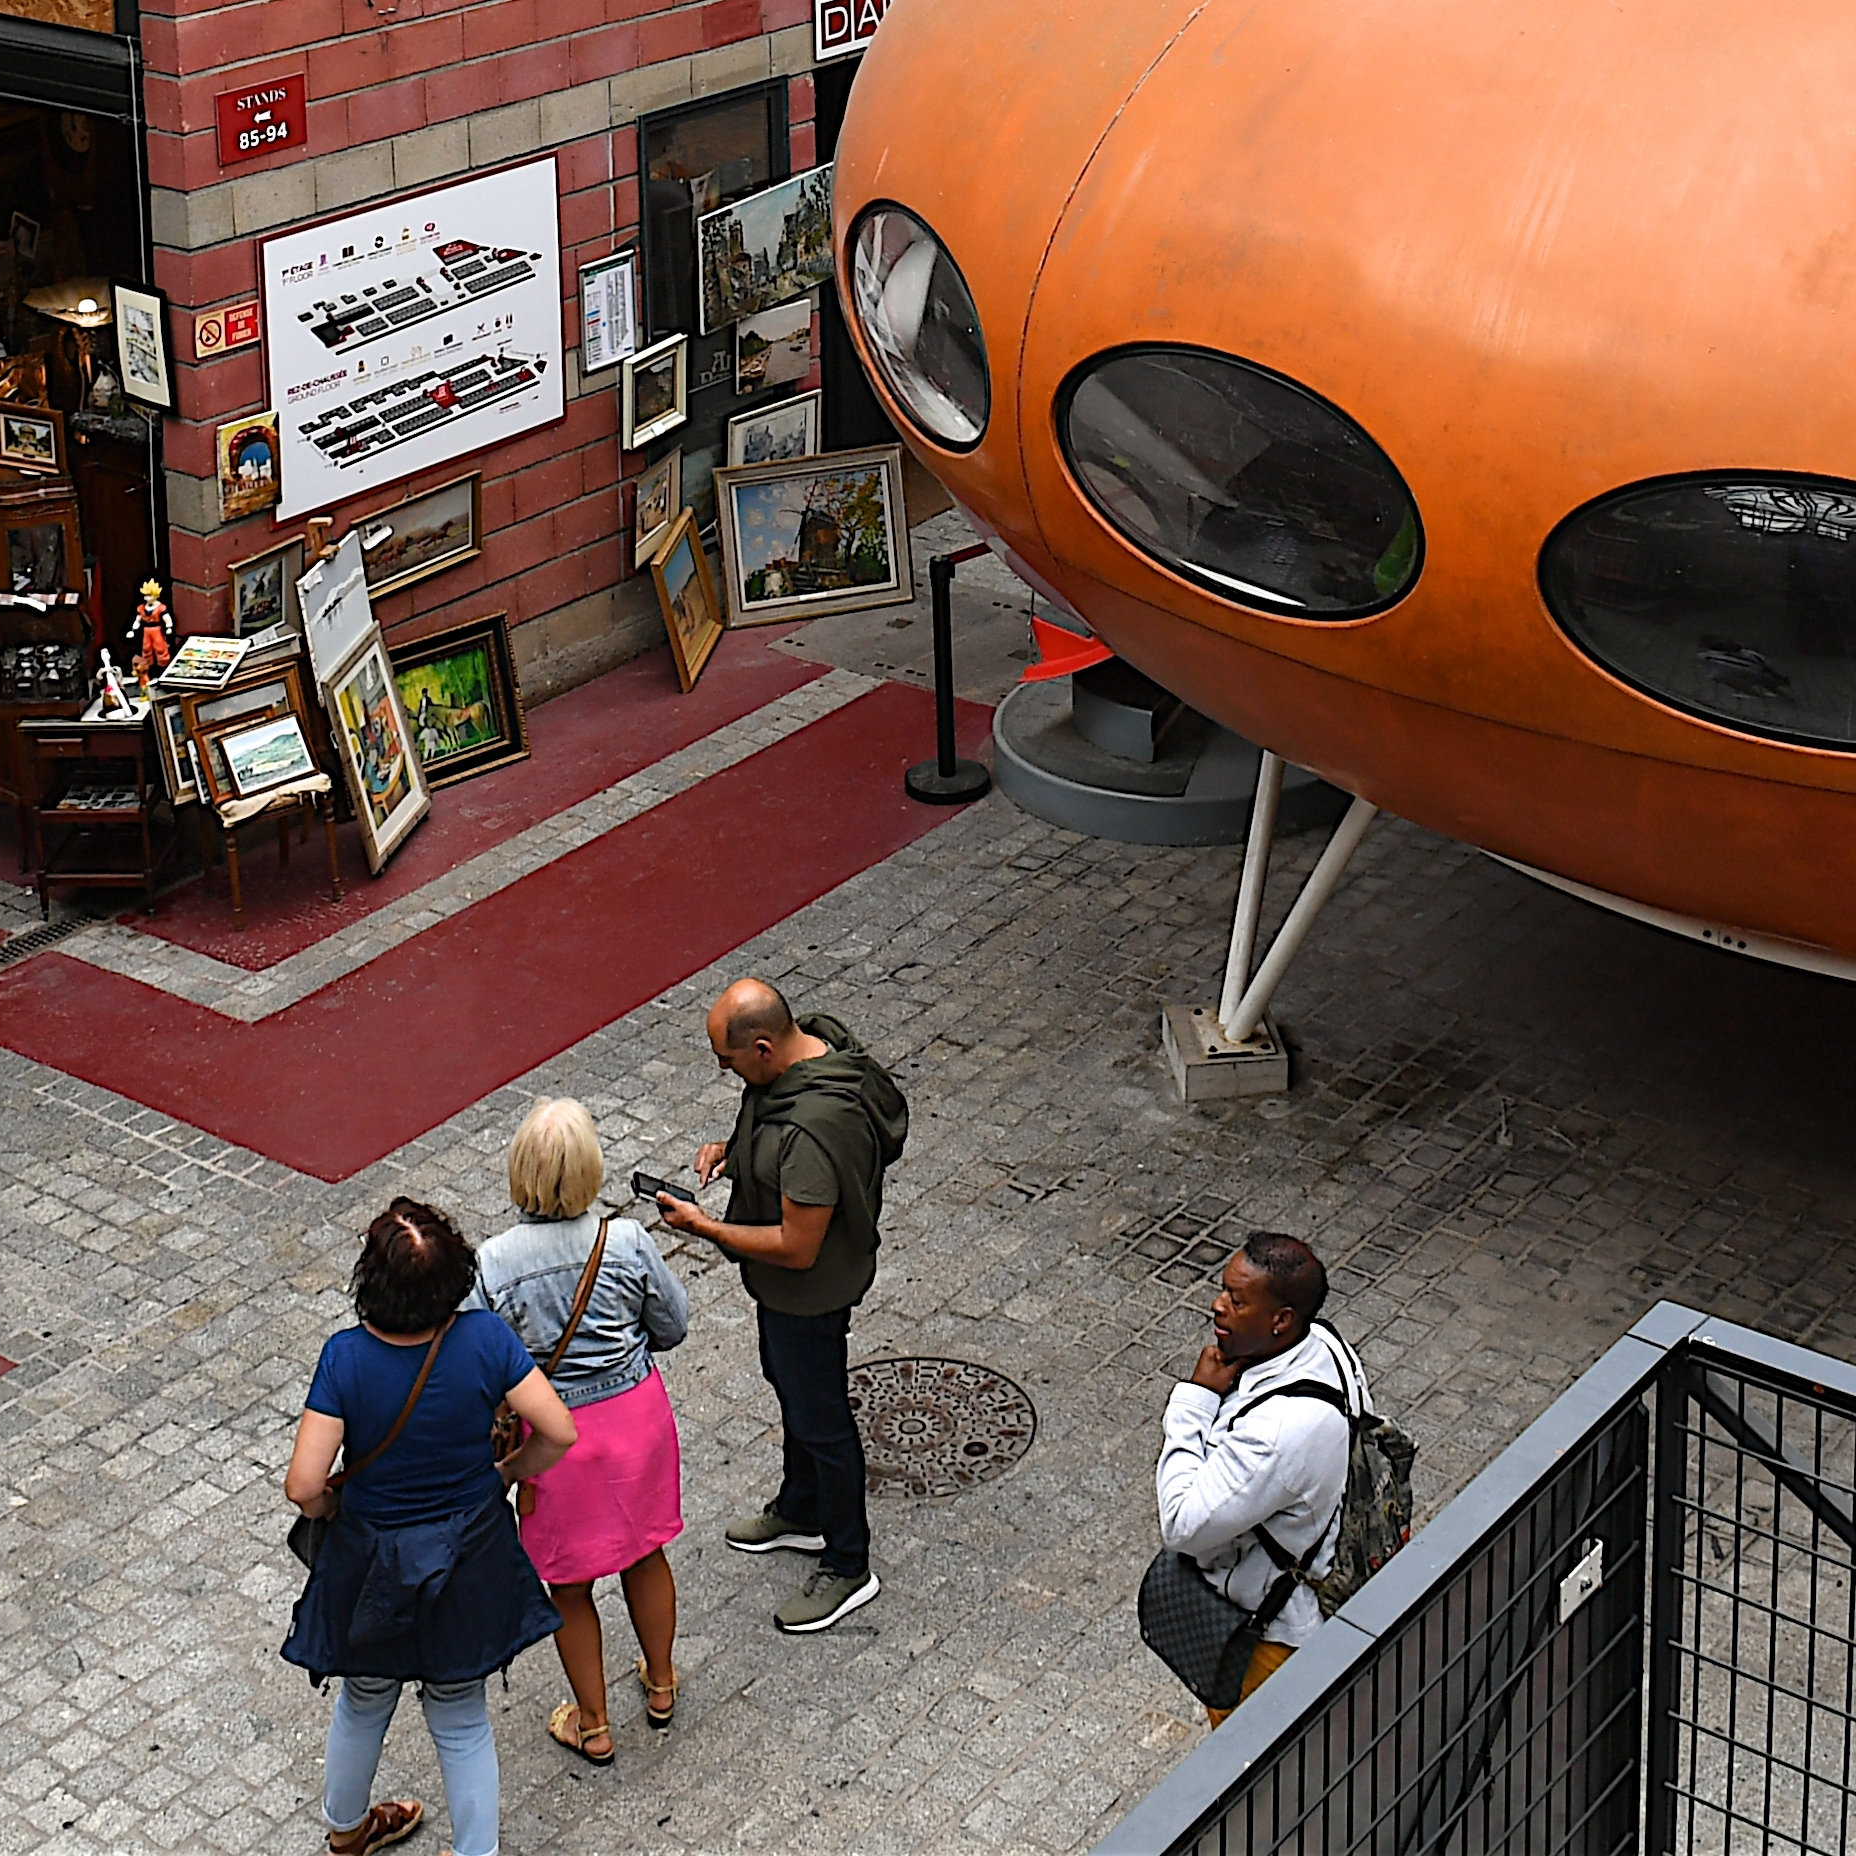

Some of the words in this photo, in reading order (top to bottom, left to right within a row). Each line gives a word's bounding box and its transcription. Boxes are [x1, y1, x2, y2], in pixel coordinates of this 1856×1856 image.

[236, 87, 287, 112] STANDS
[239, 121, 288, 150] 85-94
[287, 387, 318, 405] GROUND
[320, 380, 342, 397] FLOOR
